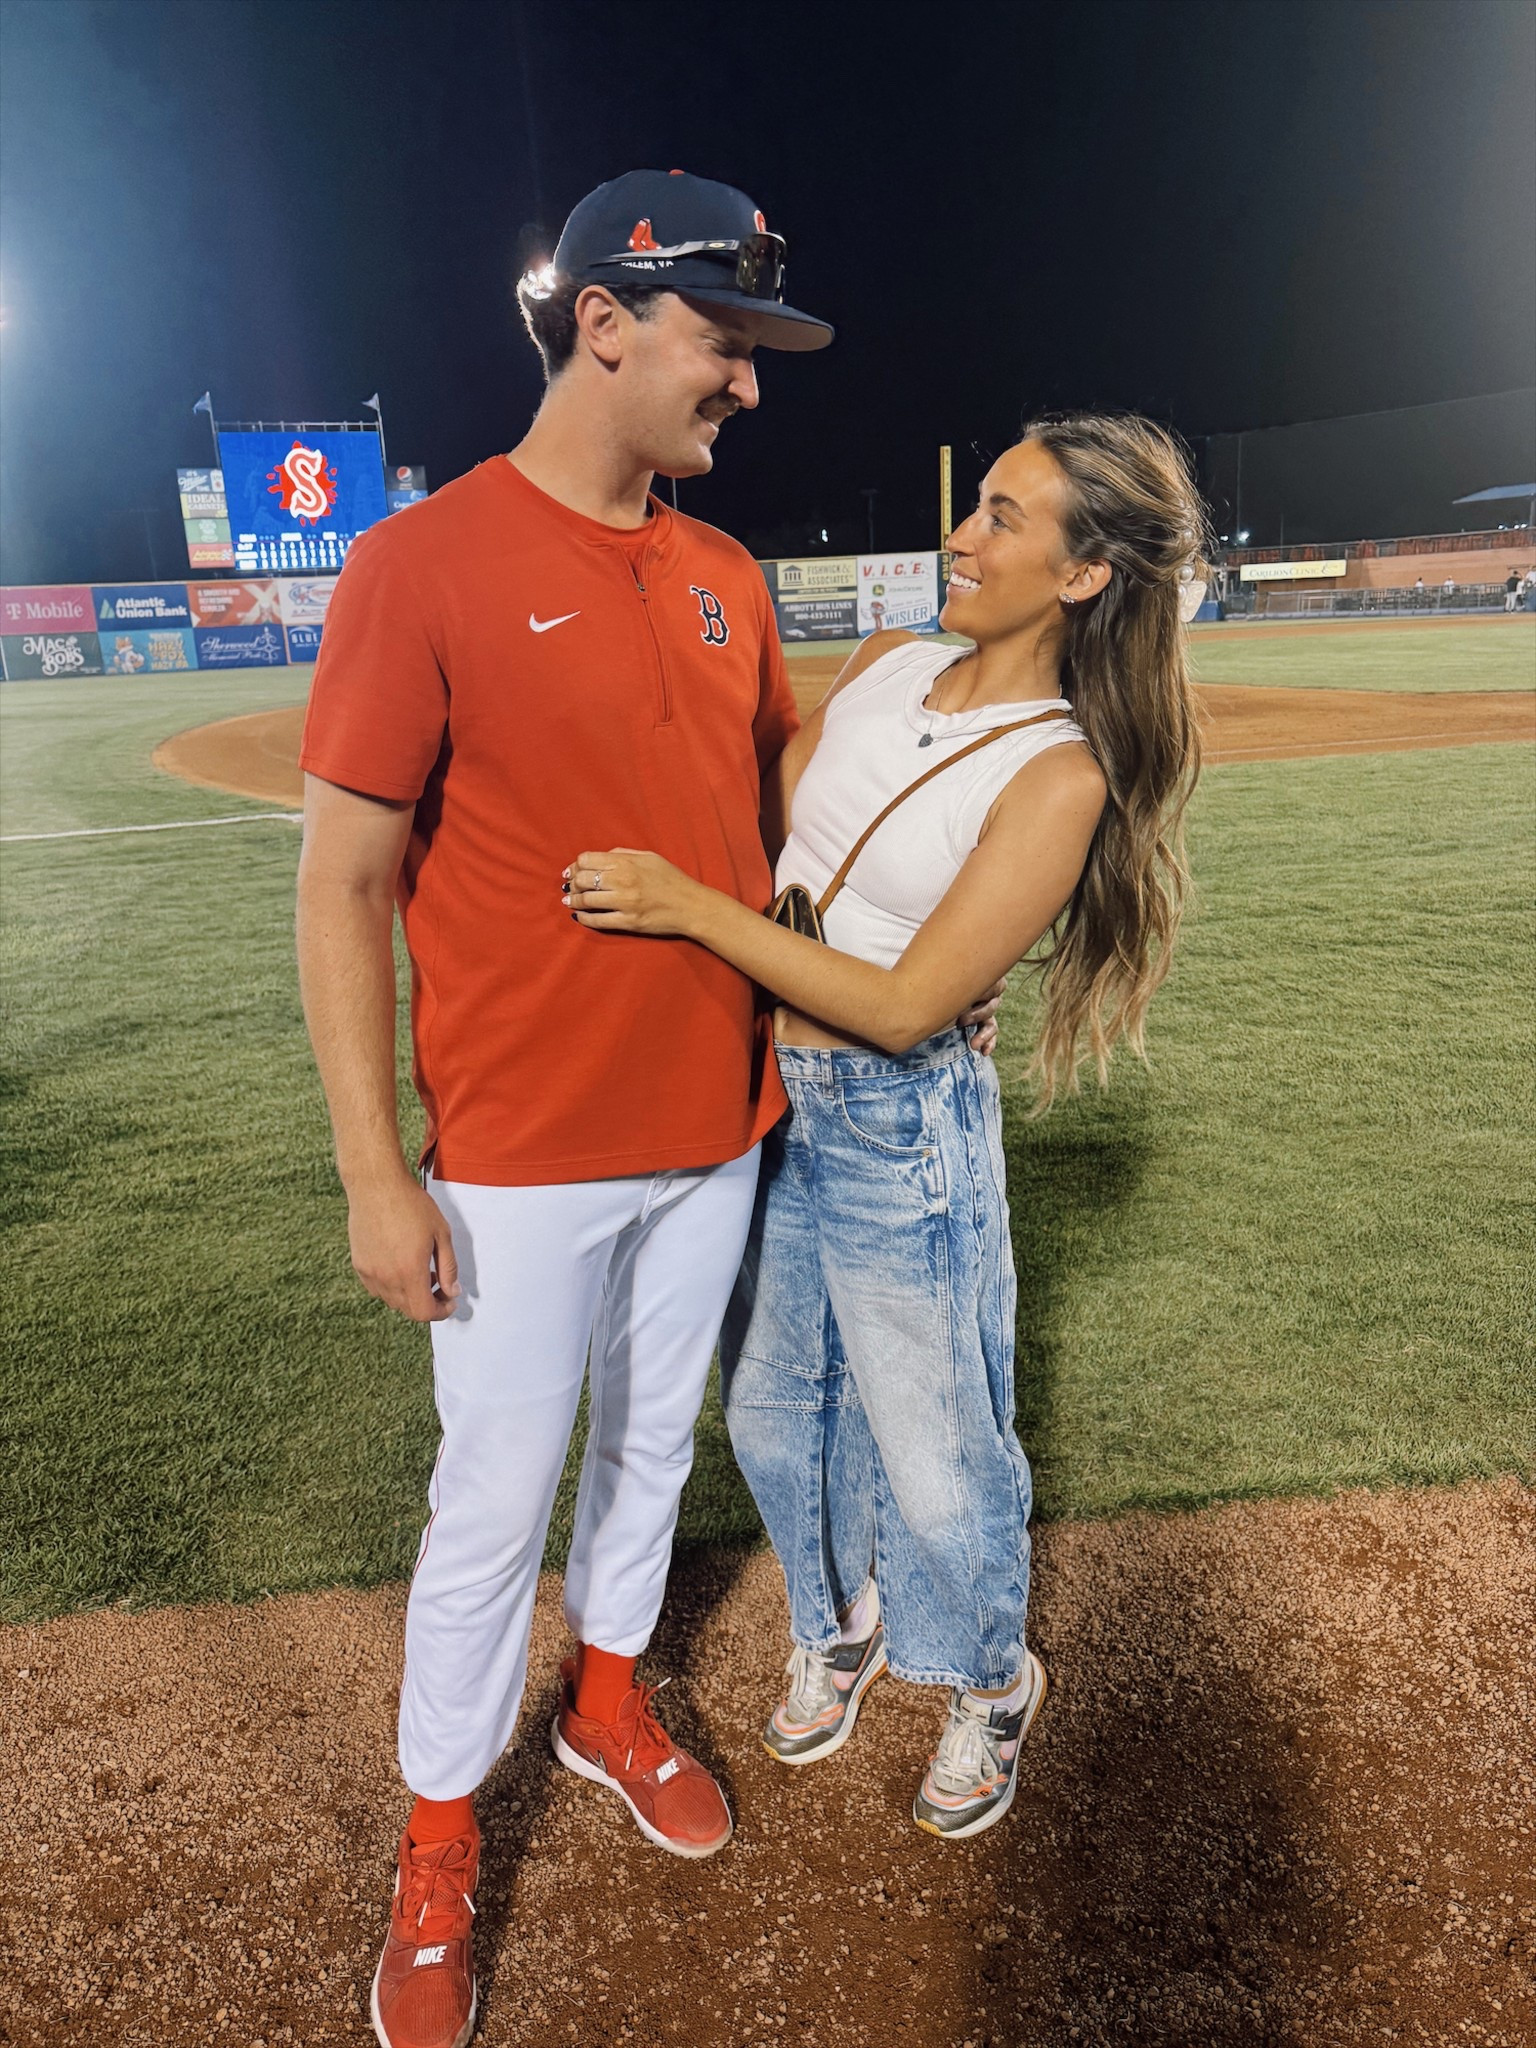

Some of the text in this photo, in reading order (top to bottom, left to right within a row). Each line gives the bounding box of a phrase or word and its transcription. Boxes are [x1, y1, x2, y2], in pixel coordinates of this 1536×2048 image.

[187, 494, 225, 504] IDEAL
[807, 575, 850, 585] ASSOCIATES
[26, 602, 84, 619] Mobile
[116, 597, 165, 609] Atlantic
[784, 601, 853, 613] ABBOTT BUS LINES
[116, 605, 188, 618] Union Bank
[690, 585, 730, 646] B
[885, 606, 928, 627] WISLER
[656, 1757, 680, 1784] NIKE
[412, 1945, 448, 1968] NIKE
